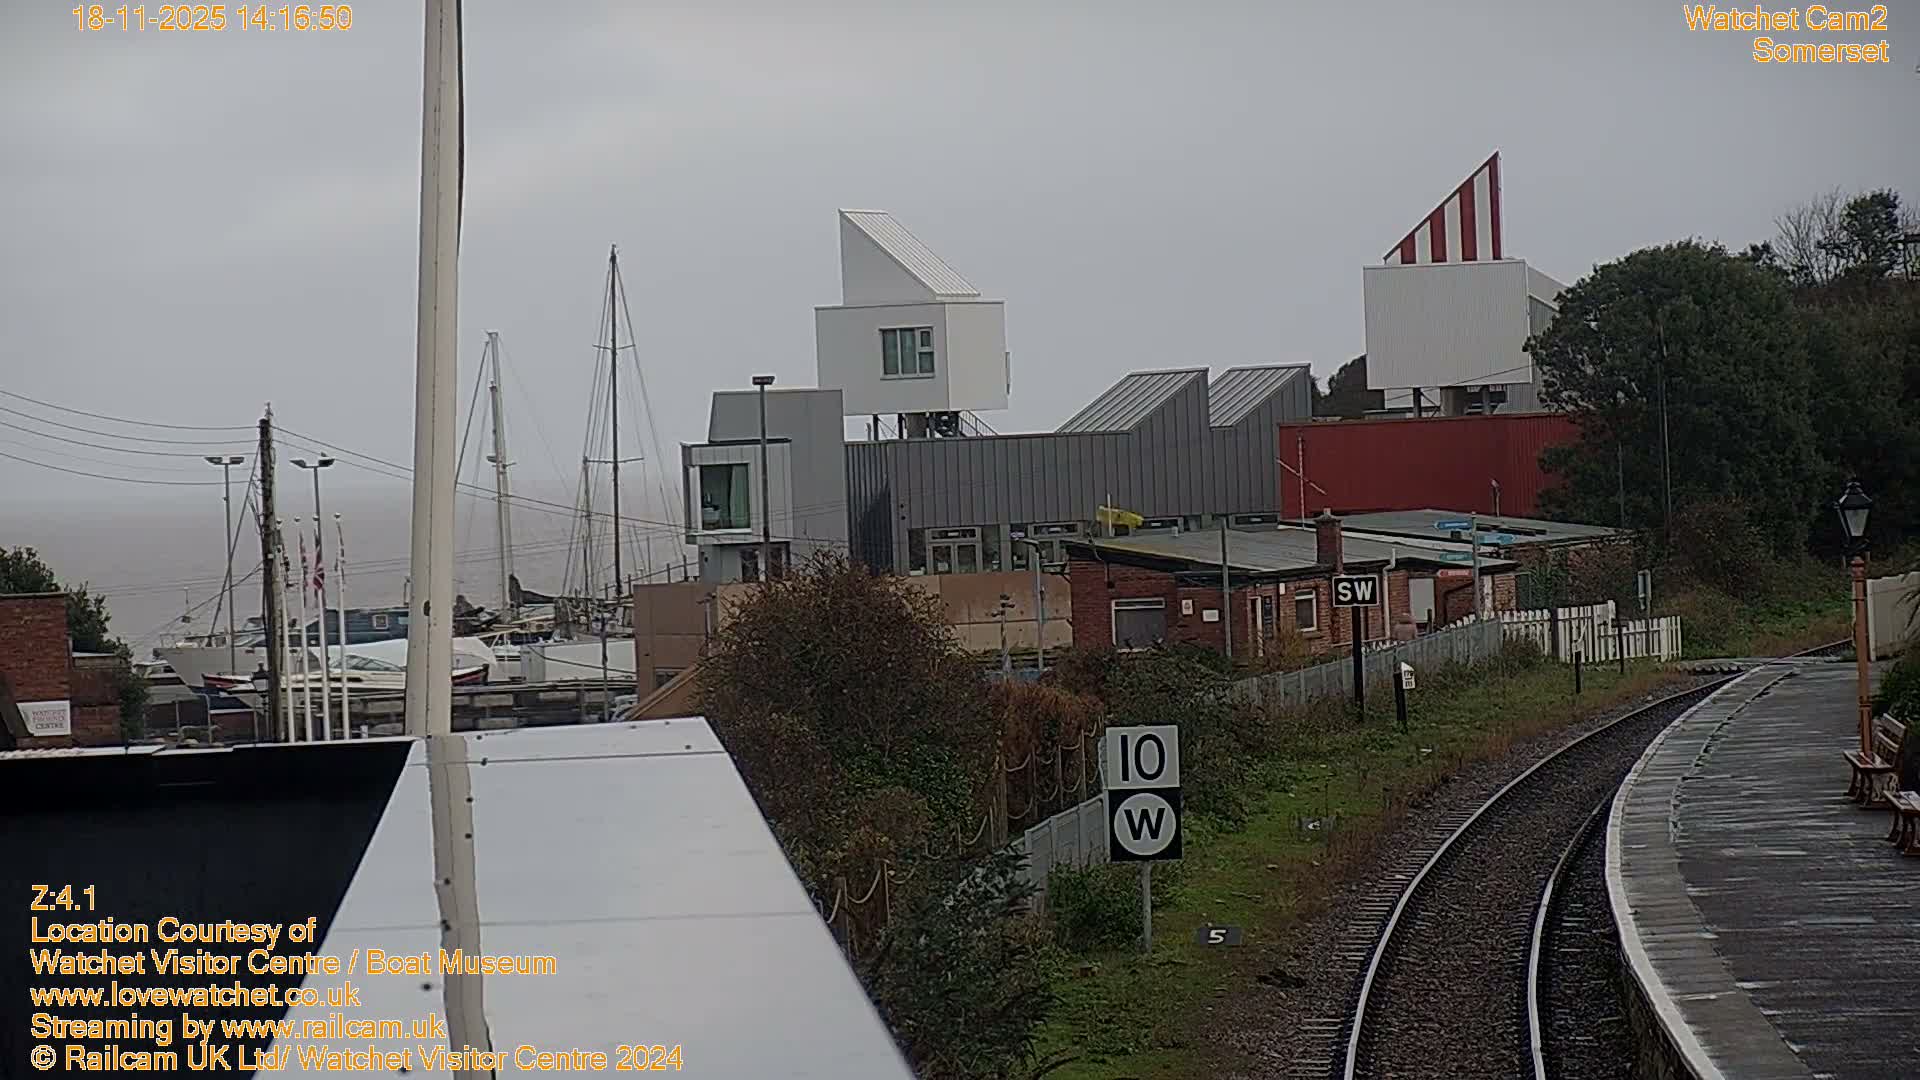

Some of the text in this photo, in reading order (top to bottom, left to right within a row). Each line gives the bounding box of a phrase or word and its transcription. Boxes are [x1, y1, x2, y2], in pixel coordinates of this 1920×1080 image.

[1337, 580, 1373, 602] SW
[1119, 733, 1166, 782] 10
[1123, 807, 1166, 841] W
[1207, 929, 1227, 944] 5
